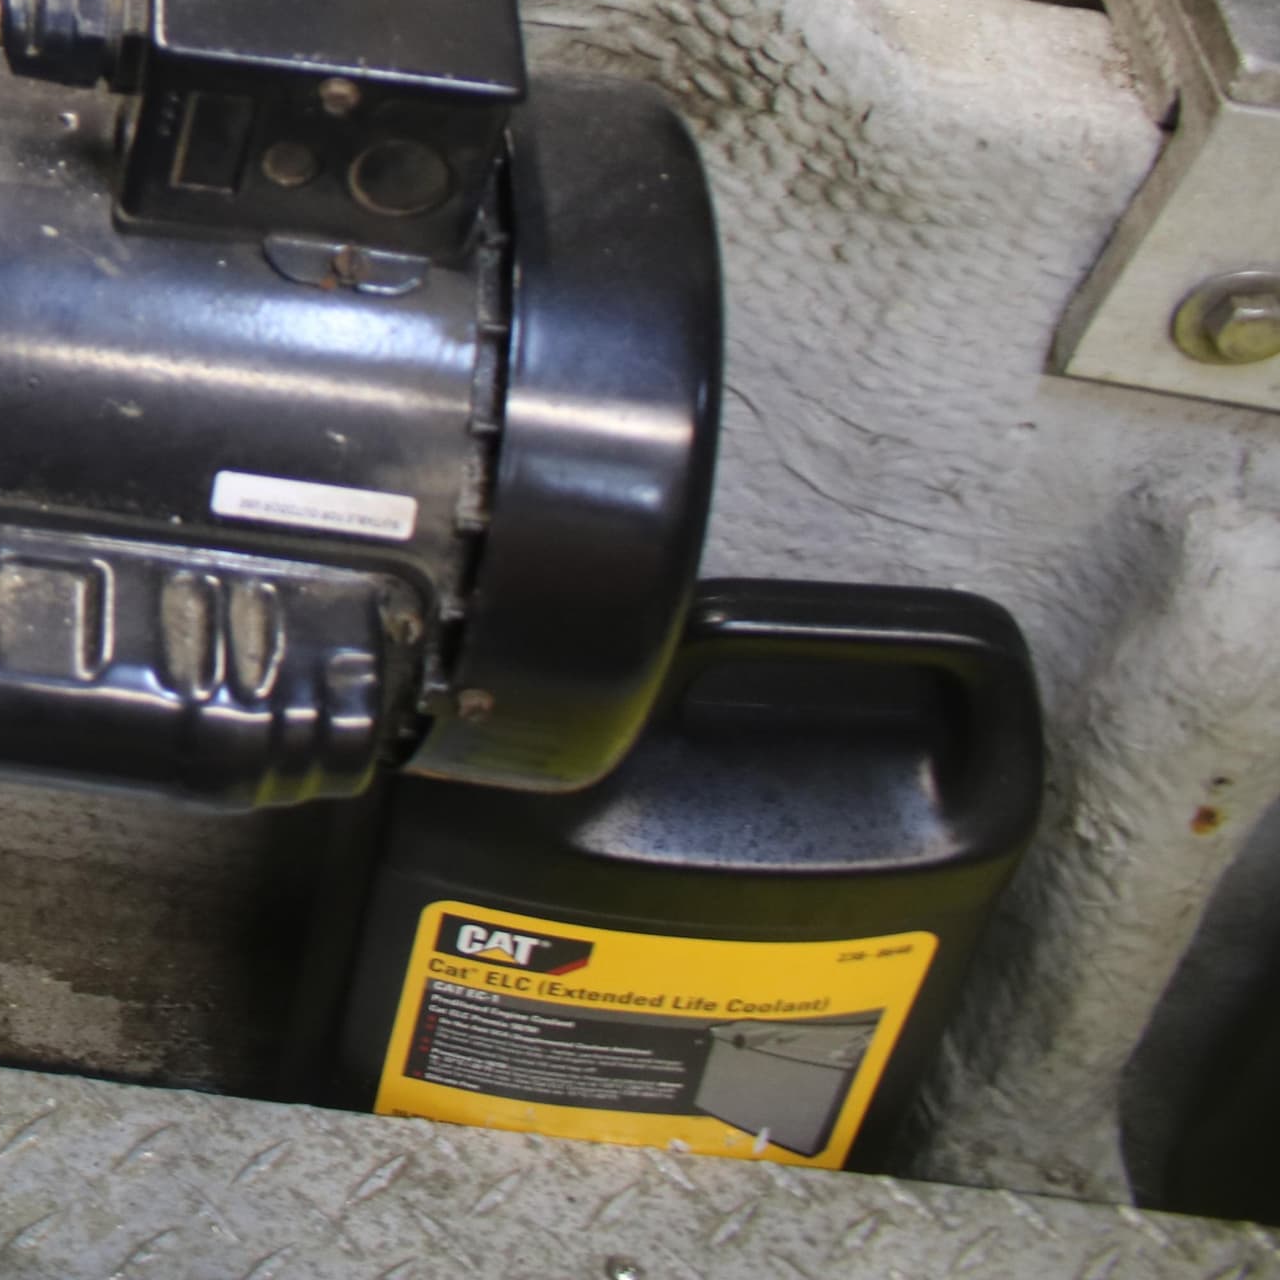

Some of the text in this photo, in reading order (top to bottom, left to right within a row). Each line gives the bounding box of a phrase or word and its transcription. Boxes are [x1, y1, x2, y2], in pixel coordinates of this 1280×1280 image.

[456, 924, 540, 966] CAT
[485, 971, 532, 992] ELC
[538, 981, 666, 1009] (Extended
[671, 996, 718, 1012] Life
[726, 997, 830, 1014] Coolant)
